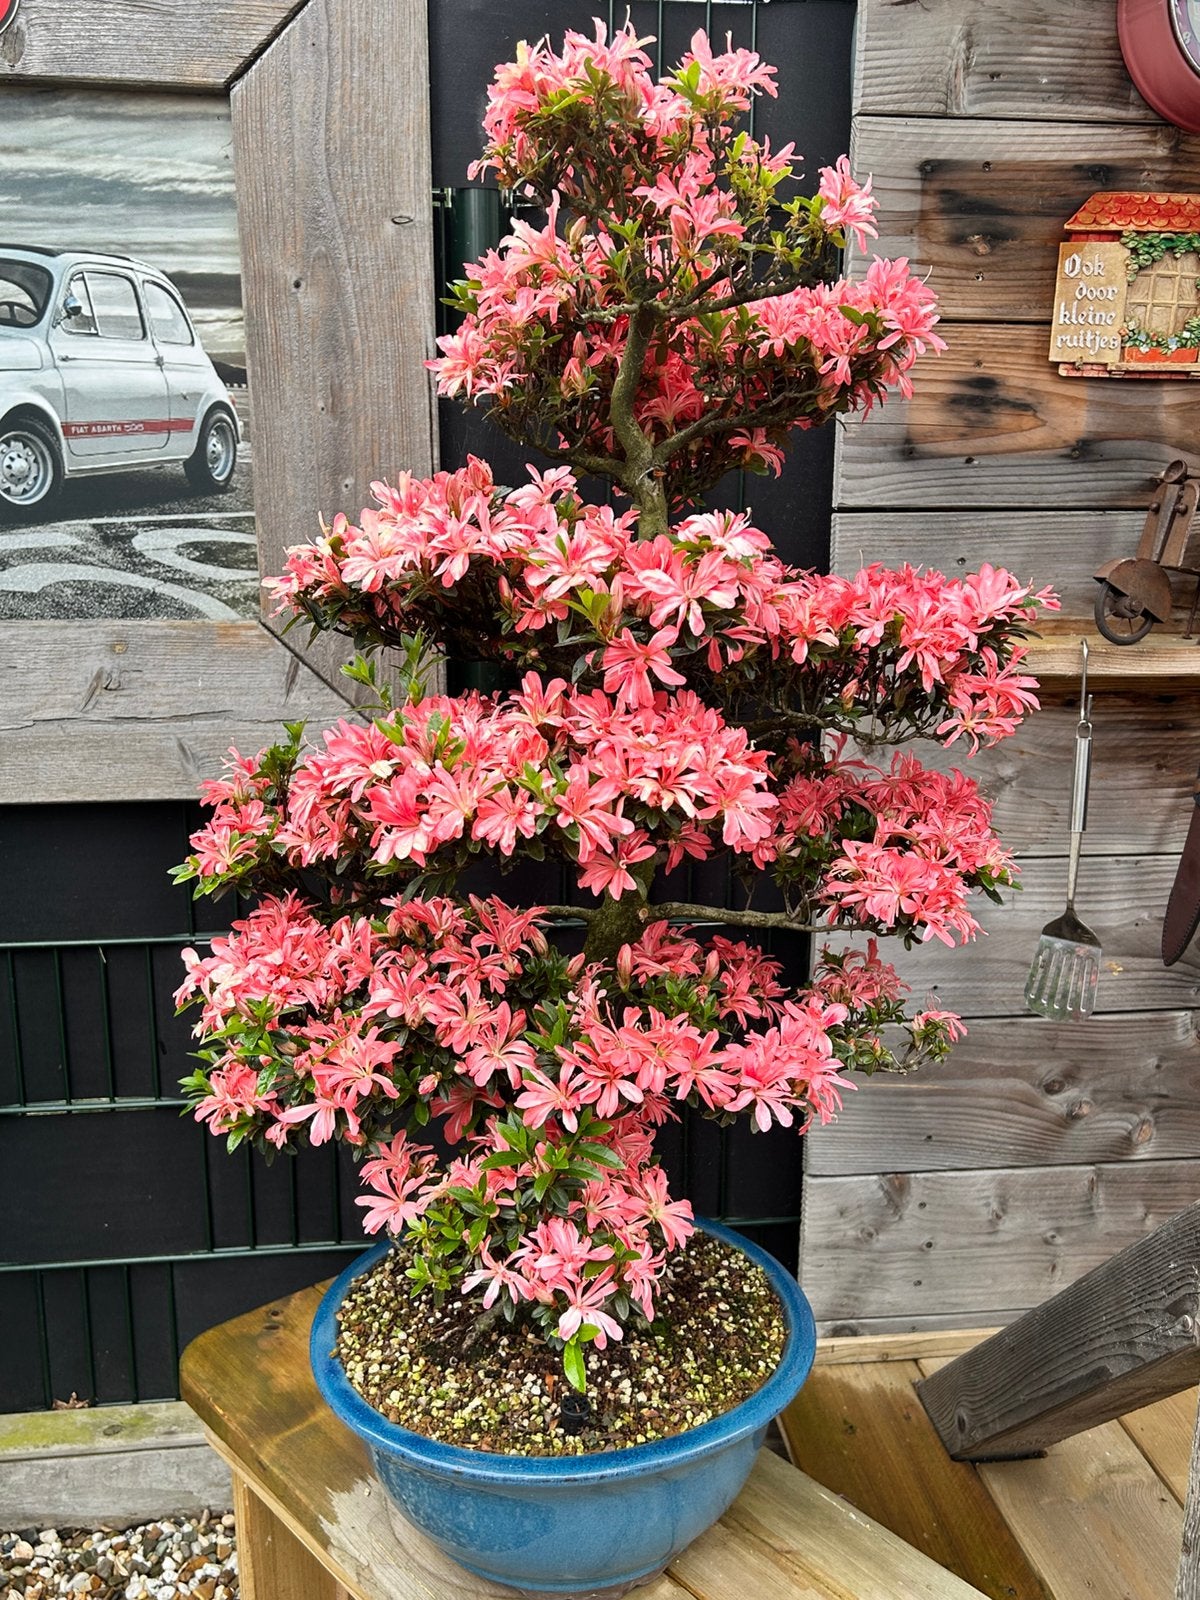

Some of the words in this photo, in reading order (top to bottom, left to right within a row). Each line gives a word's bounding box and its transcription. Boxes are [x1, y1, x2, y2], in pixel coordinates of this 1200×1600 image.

[1064, 253, 1105, 278] Ook
[1075, 281, 1118, 301] door
[1058, 302, 1116, 325] kleine
[1056, 330, 1119, 355] ruitjes
[71, 425, 89, 434] FIAT
[91, 424, 121, 433] ABARTH
